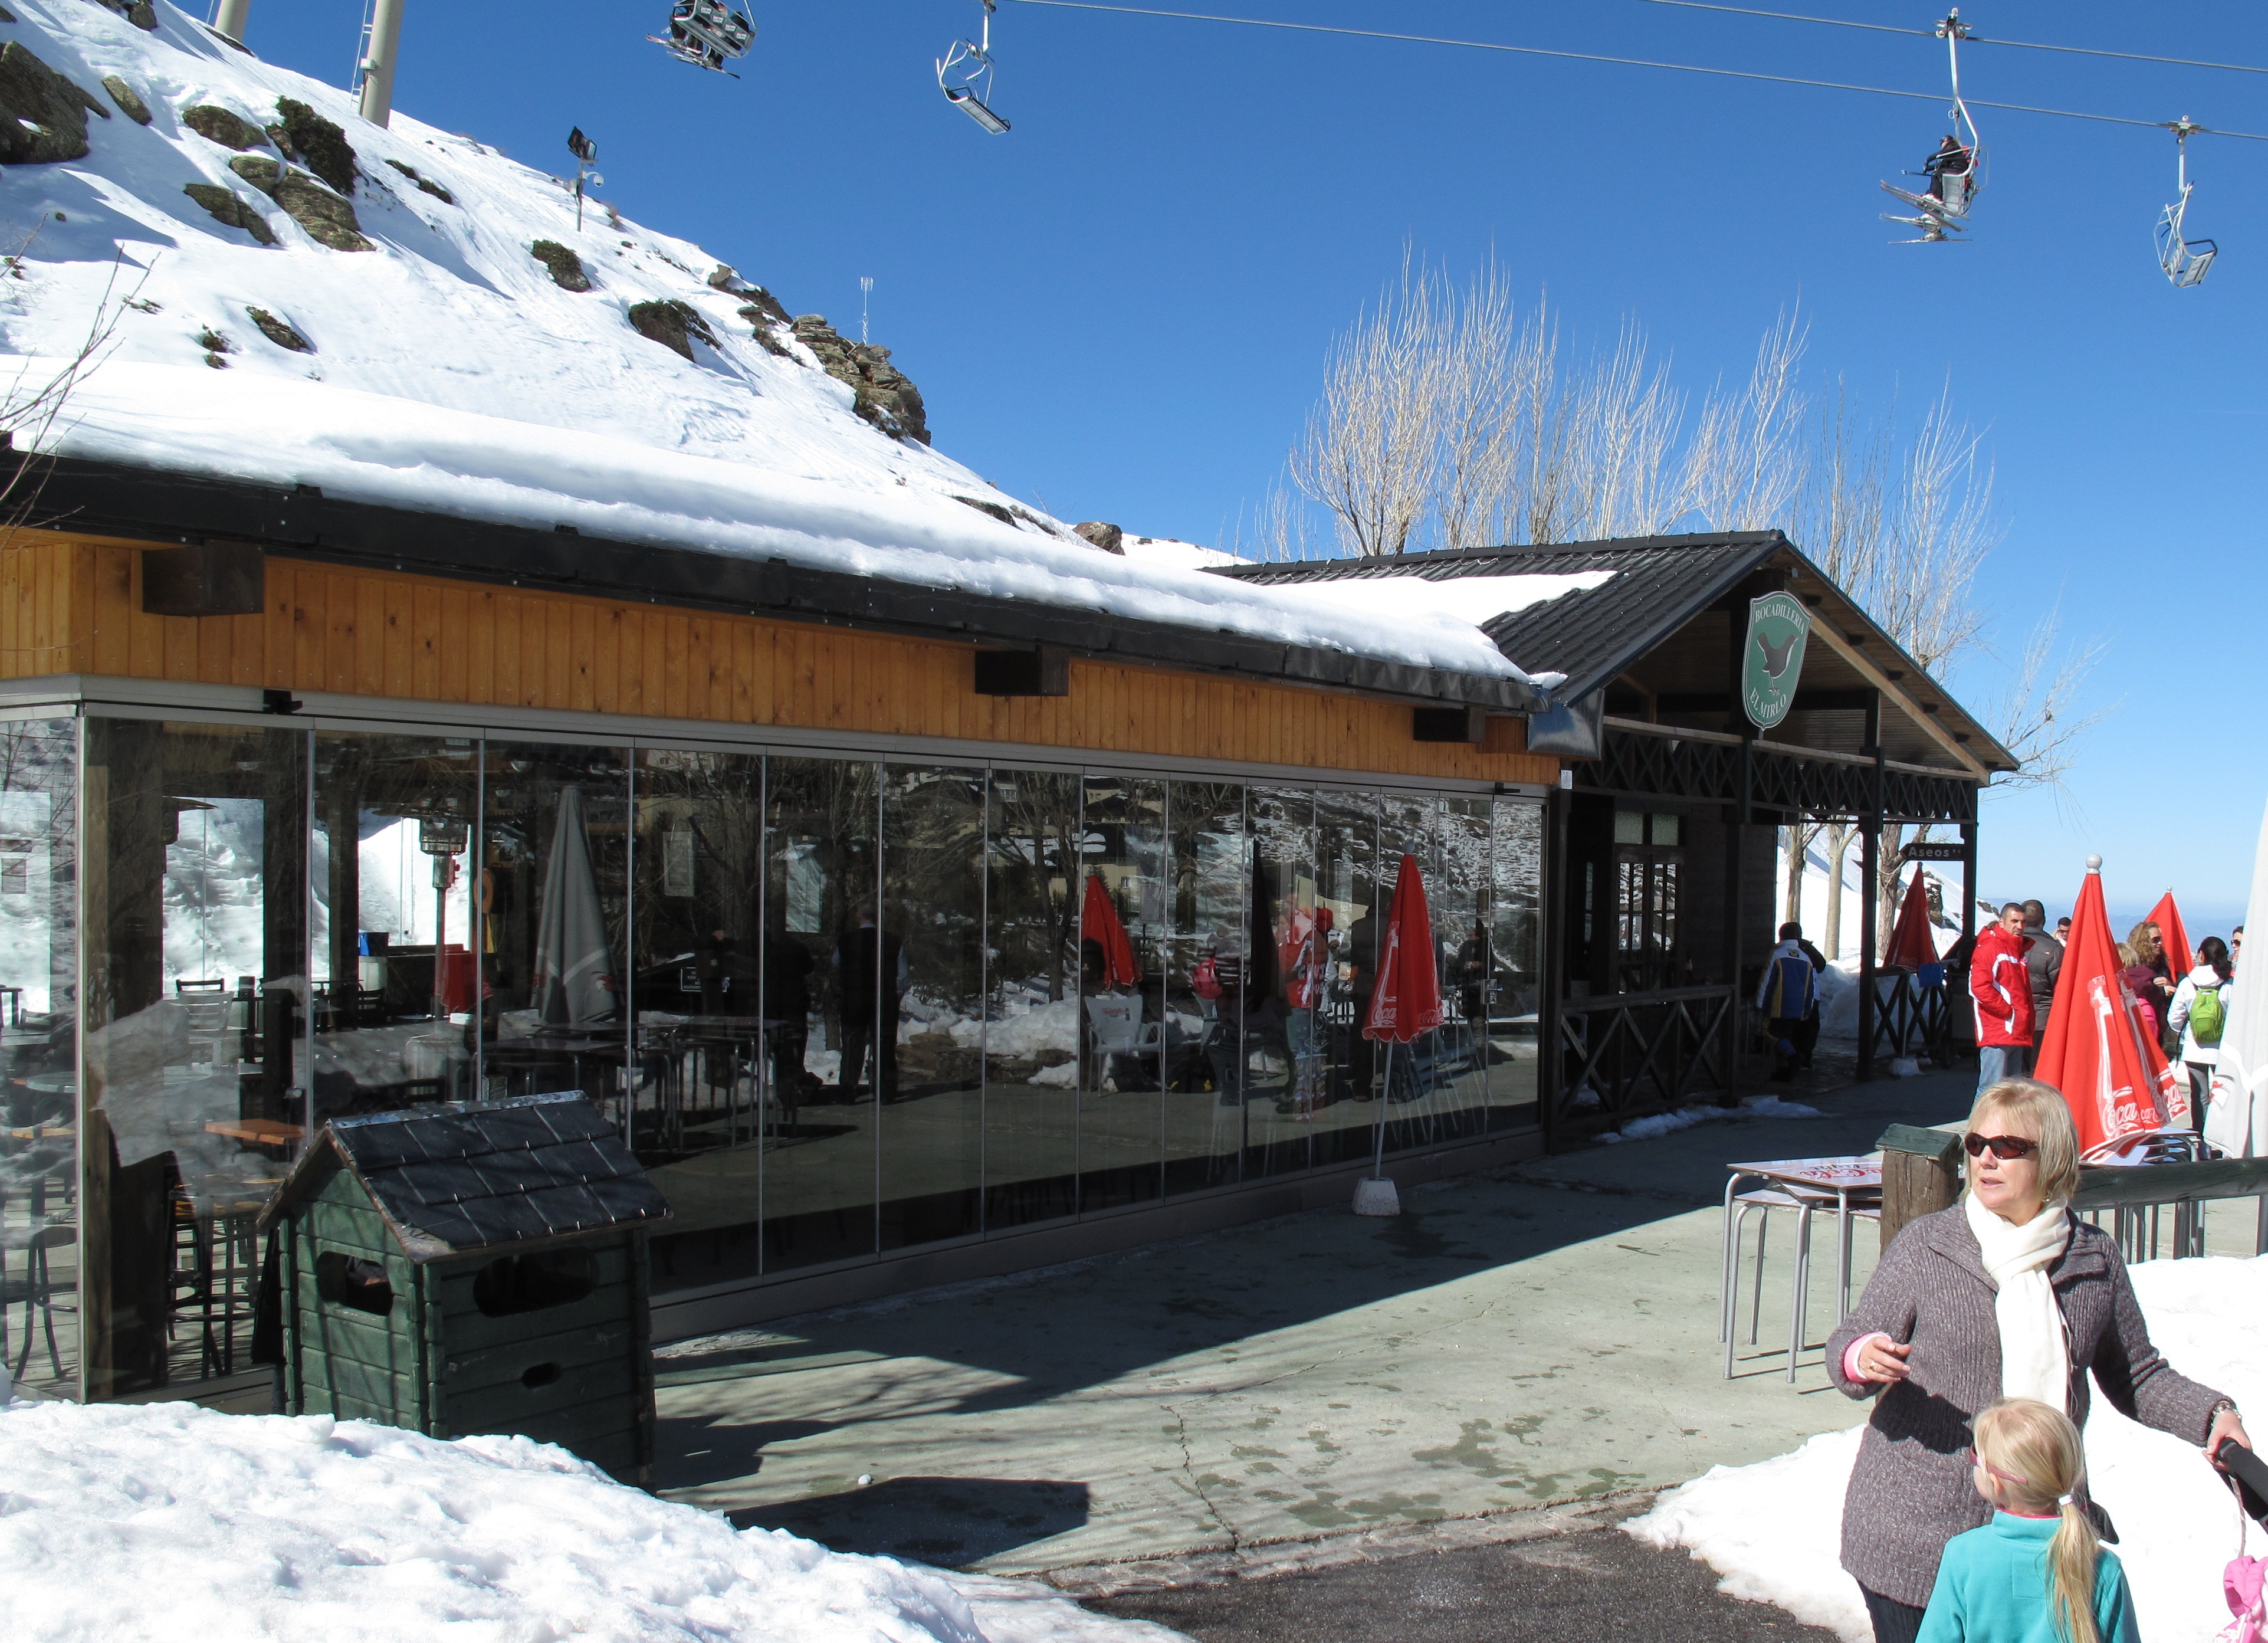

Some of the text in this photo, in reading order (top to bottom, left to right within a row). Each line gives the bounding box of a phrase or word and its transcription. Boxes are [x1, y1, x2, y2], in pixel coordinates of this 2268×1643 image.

[1755, 604, 1805, 635] BOCADILLERIA
[1750, 687, 1787, 719] EL MIRLO
[1908, 846, 1949, 857] Aseos
